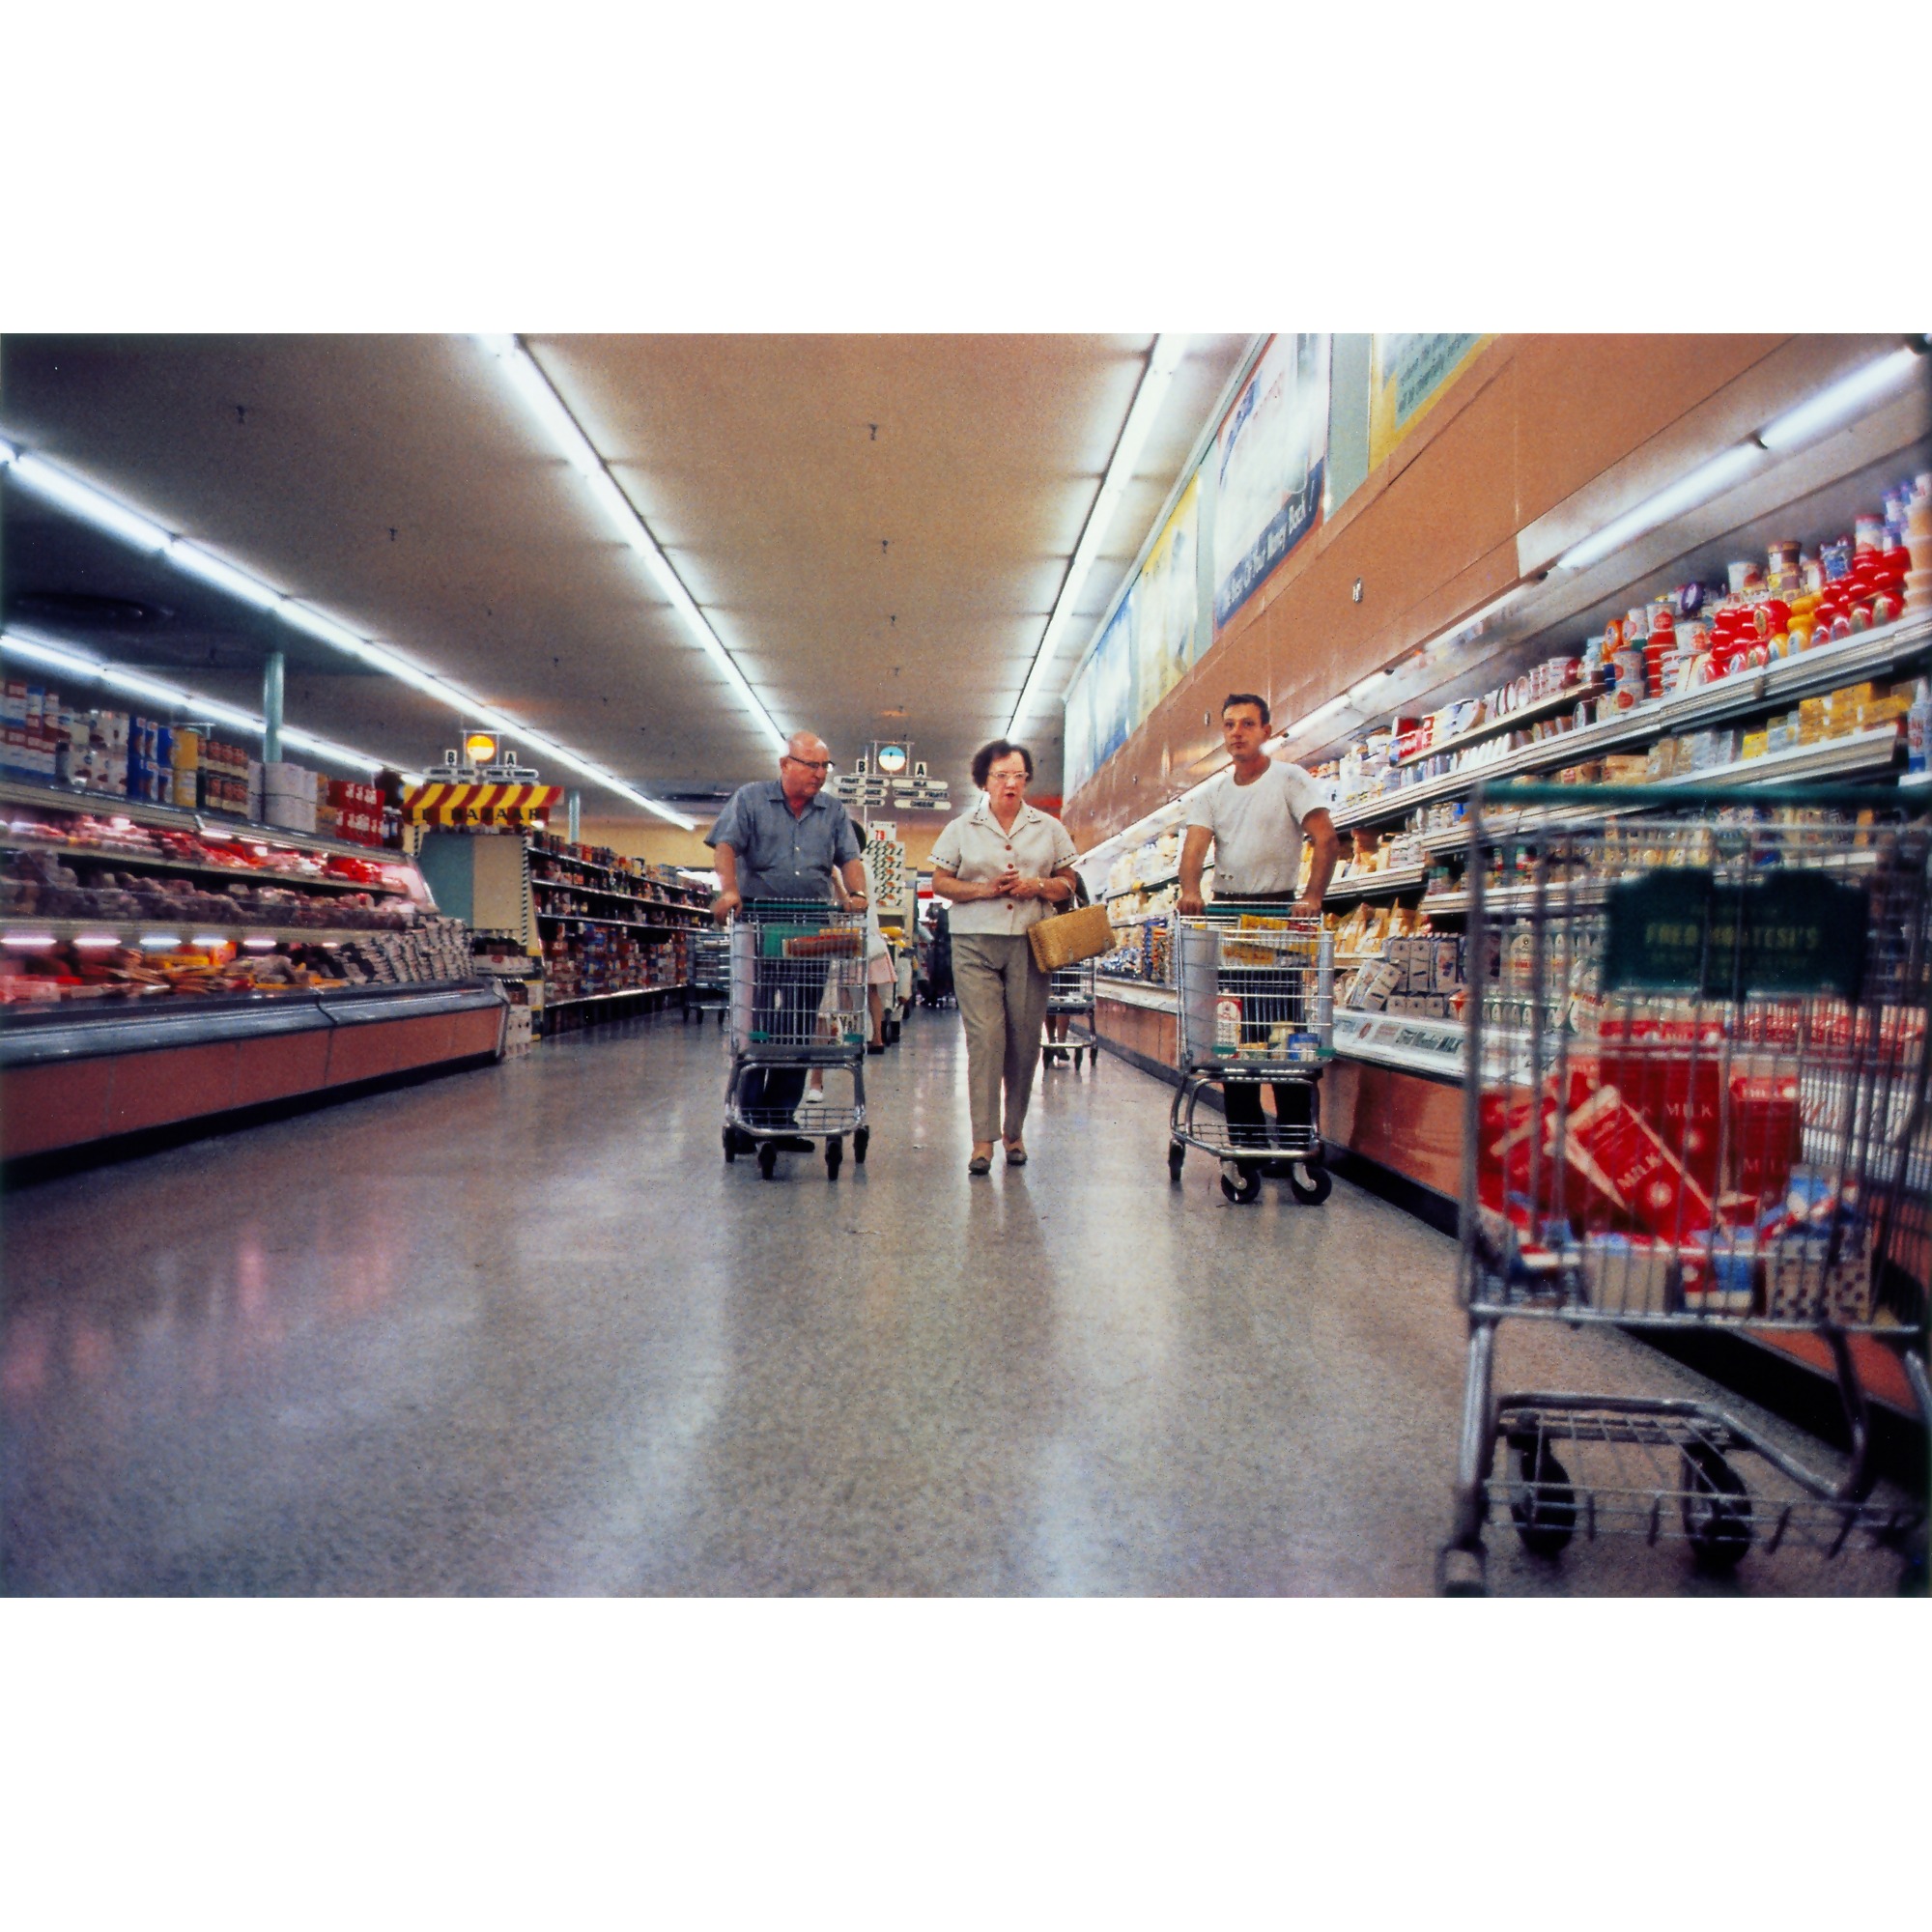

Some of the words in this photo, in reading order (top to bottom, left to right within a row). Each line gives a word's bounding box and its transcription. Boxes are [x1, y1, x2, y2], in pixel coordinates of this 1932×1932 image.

[447, 752, 454, 763] B
[507, 753, 515, 764] A
[858, 761, 865, 772] B
[917, 764, 924, 775] A
[1617, 1152, 1662, 1188] MILK
